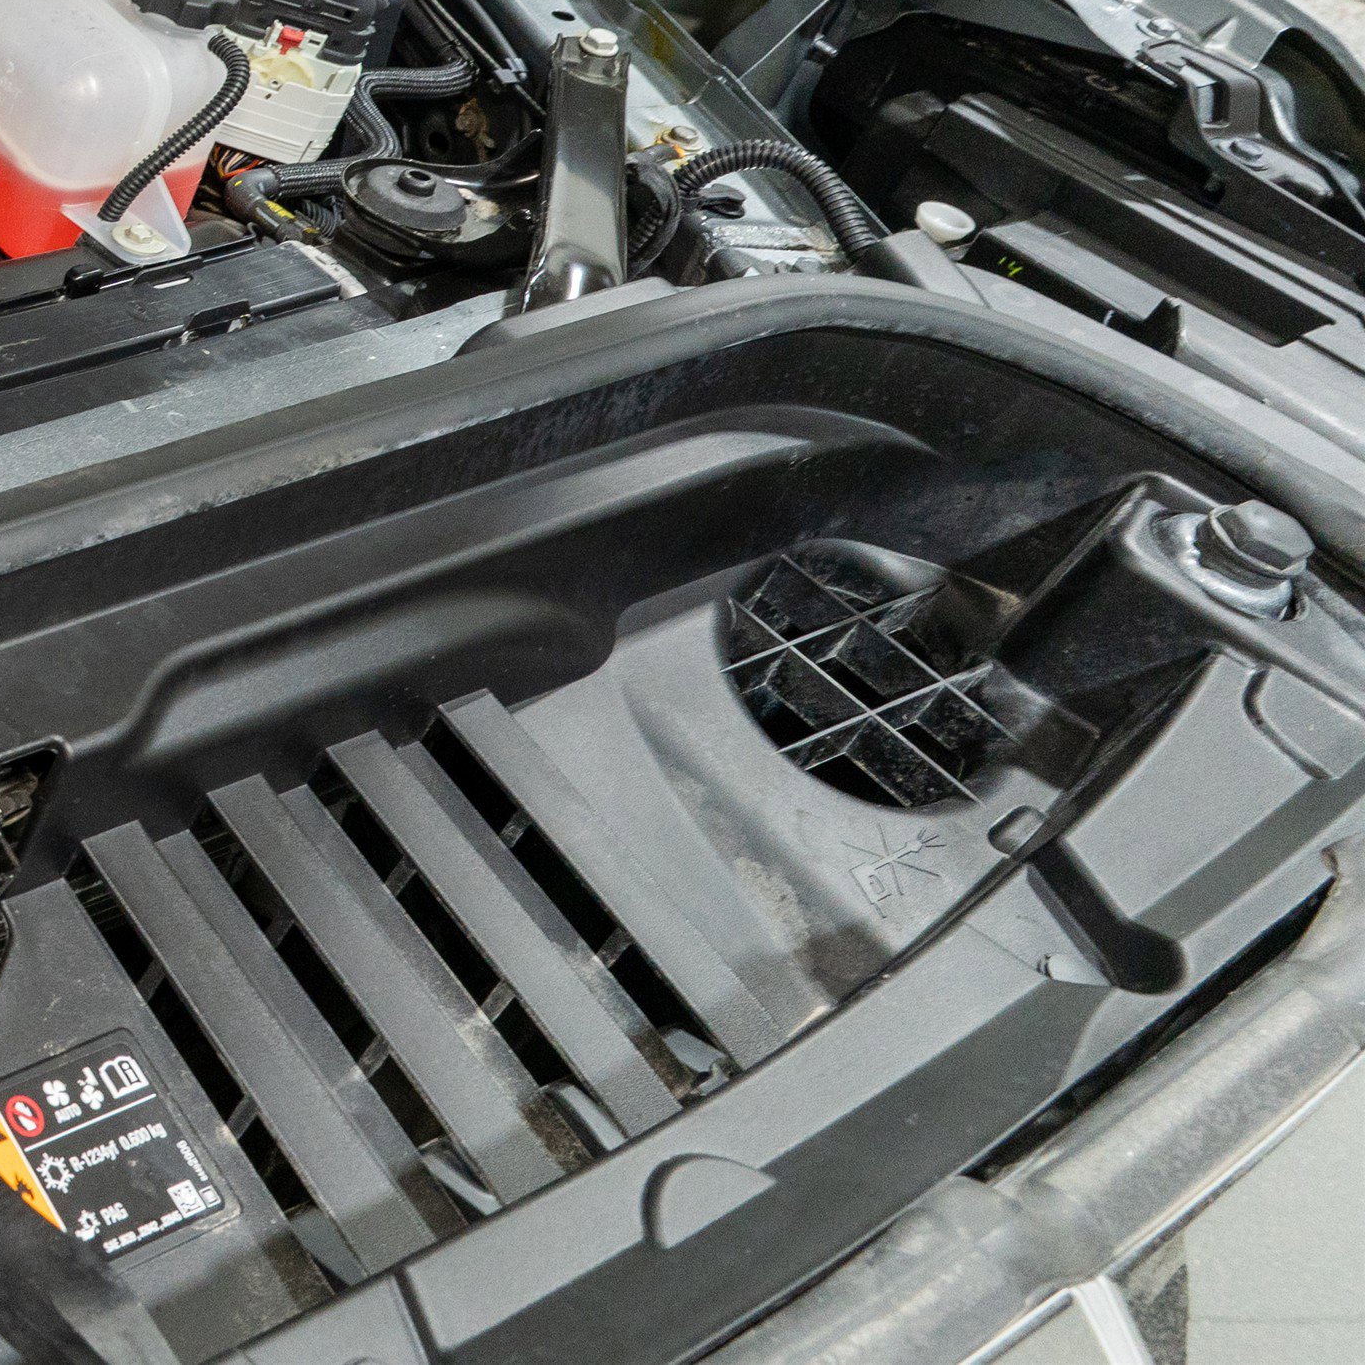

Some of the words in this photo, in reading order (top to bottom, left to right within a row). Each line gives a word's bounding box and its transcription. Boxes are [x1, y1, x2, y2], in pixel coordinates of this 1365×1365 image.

[55, 1102, 82, 1124] AUTO
[69, 1142, 120, 1173] R-1234yf
[146, 1120, 167, 1139] kg
[99, 1201, 129, 1226] PAG
